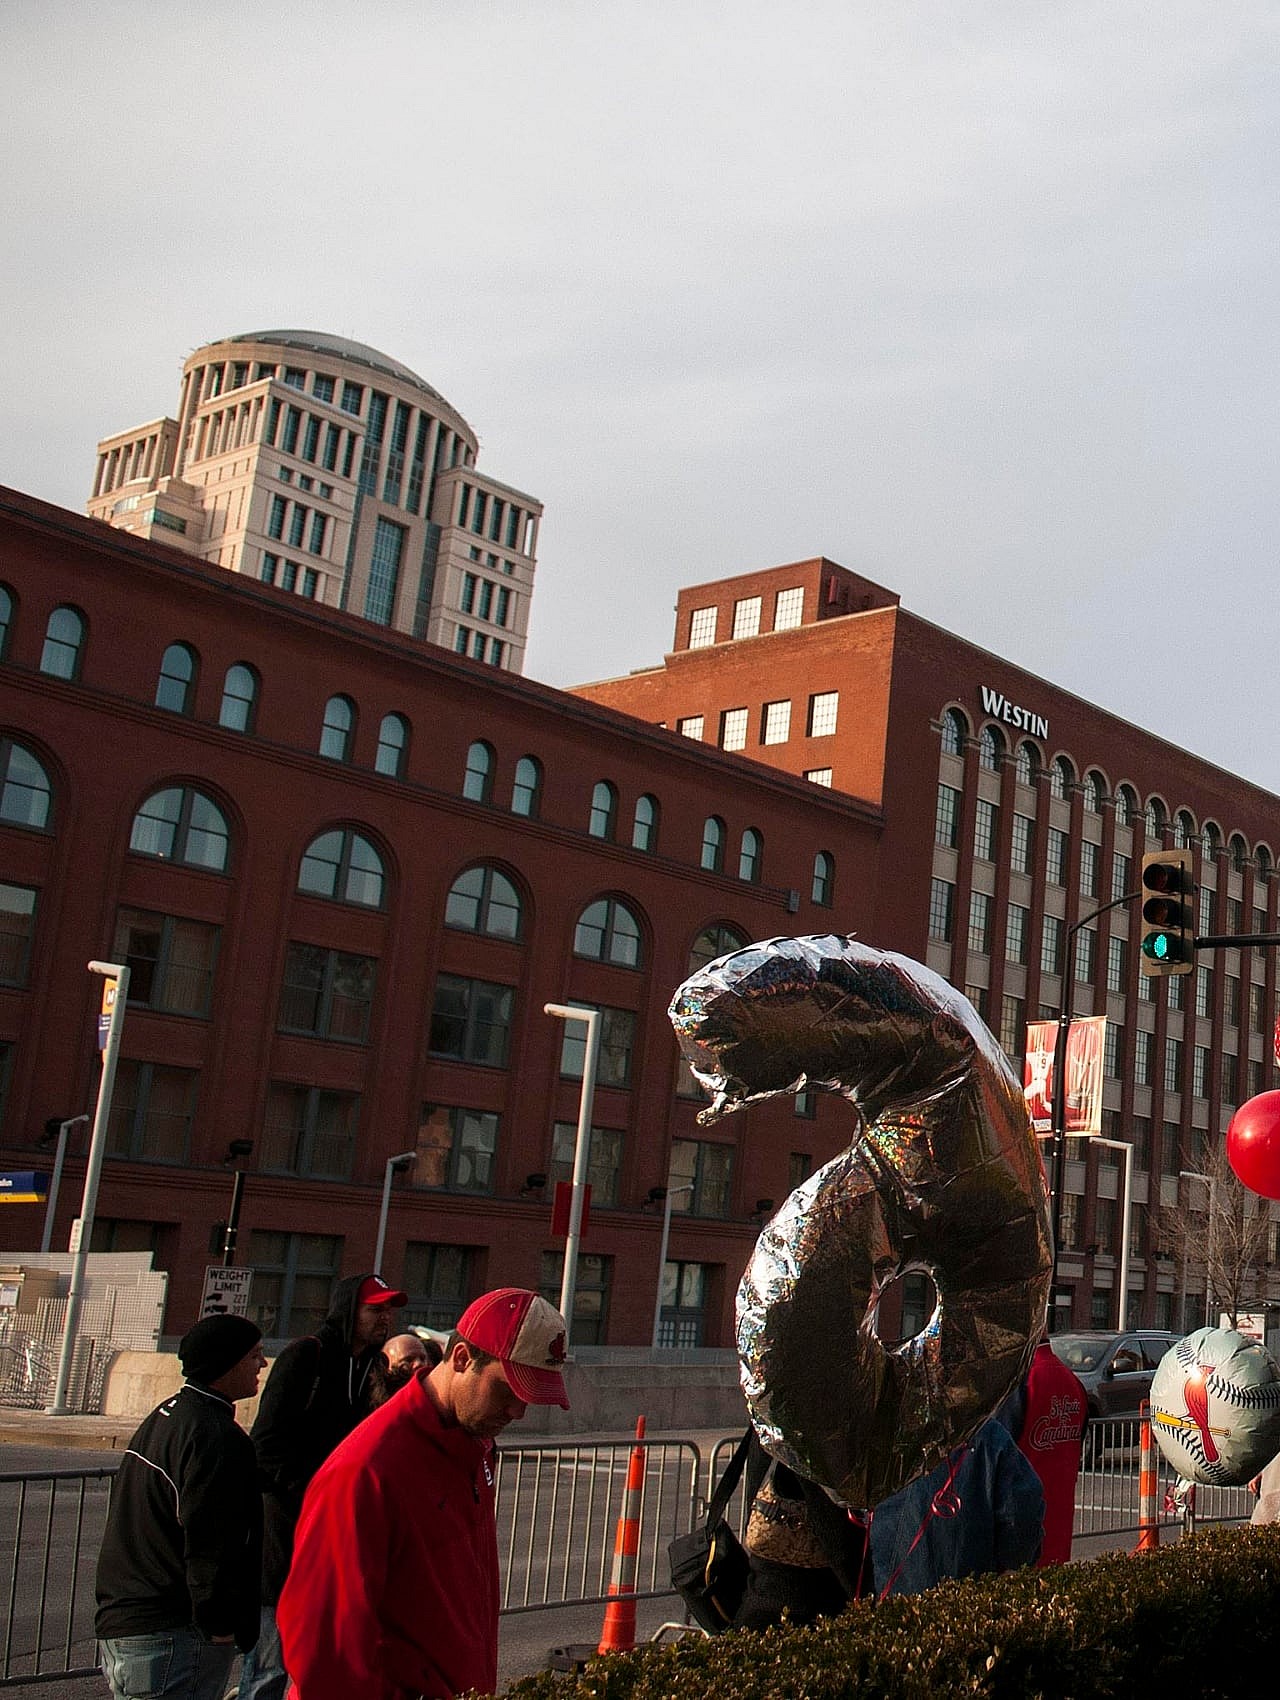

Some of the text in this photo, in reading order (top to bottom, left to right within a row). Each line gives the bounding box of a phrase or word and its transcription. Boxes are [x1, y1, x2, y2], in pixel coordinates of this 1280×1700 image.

[981, 685, 1048, 740] WESTIN
[210, 1270, 250, 1281] WEIGHT
[214, 1281, 242, 1292] LIMIT
